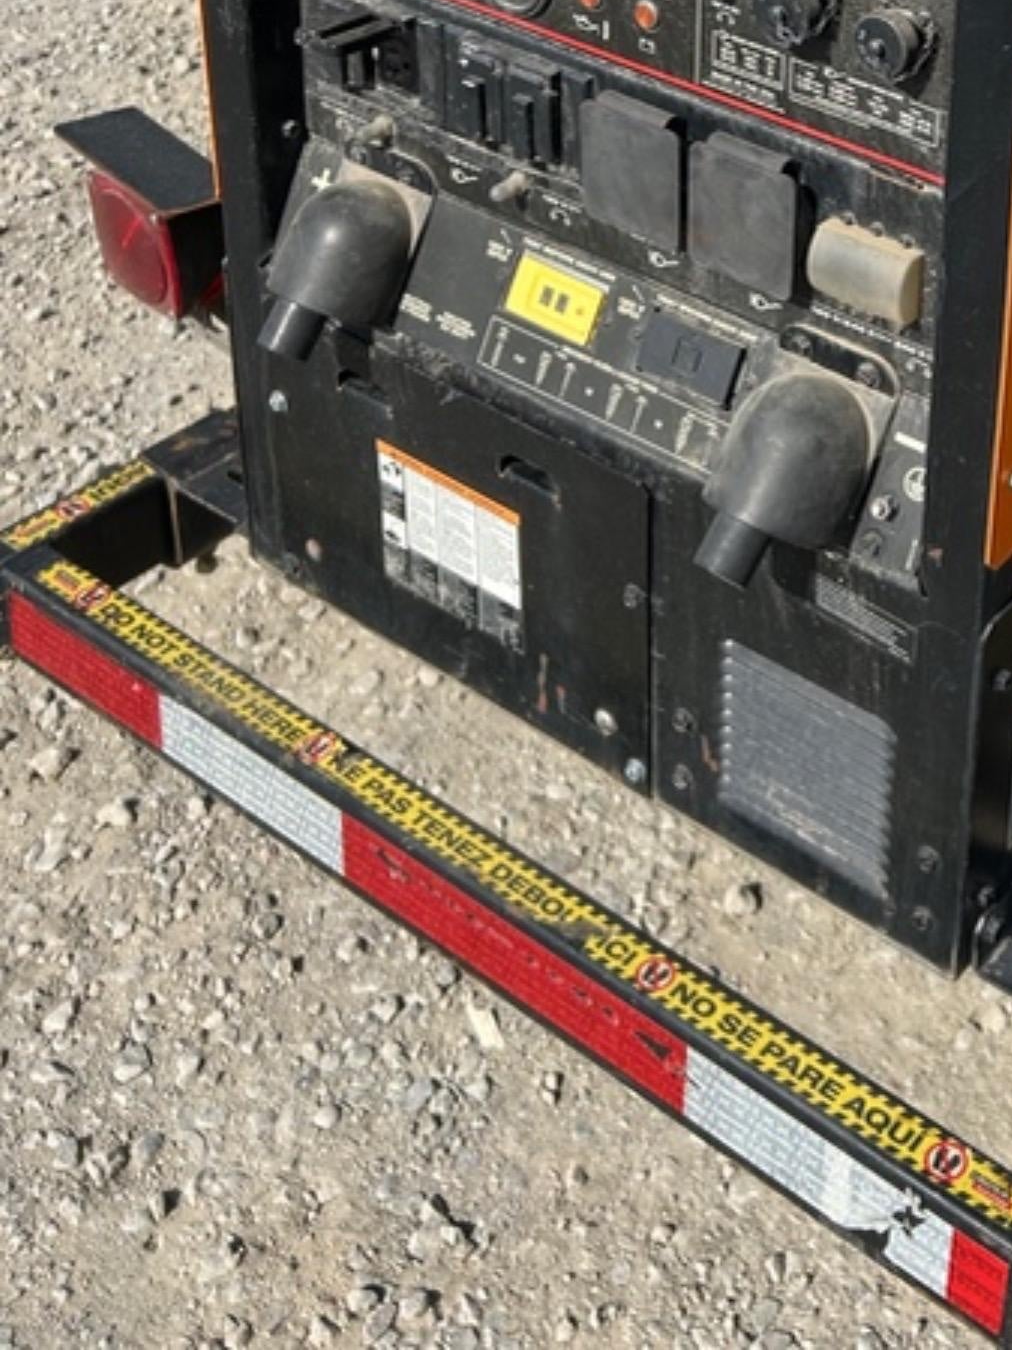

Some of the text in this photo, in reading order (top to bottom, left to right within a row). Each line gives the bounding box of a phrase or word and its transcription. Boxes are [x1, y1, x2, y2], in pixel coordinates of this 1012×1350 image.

[99, 600, 305, 744] DO NOT STAND HERE
[362, 776, 414, 814] PAS
[412, 808, 494, 868] TENEZ
[668, 979, 718, 1020] NO
[717, 1011, 759, 1045] SE
[760, 1042, 846, 1103] PARE
